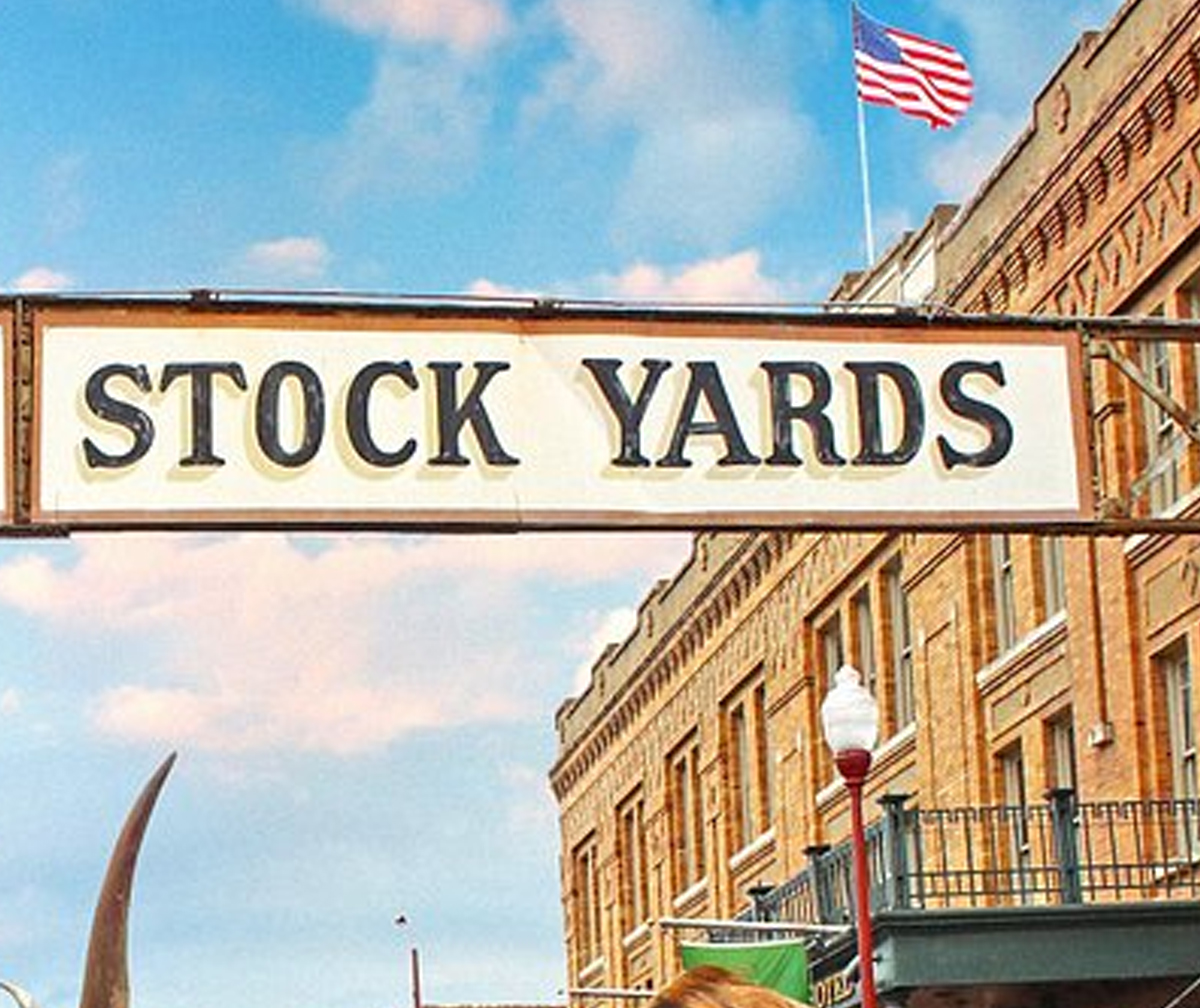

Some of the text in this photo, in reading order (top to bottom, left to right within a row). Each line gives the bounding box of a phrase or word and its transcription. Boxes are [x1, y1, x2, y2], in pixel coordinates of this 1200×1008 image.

[82, 360, 521, 468] STOCK
[581, 357, 1015, 470] YARDS
[812, 972, 853, 1008] OTEL
